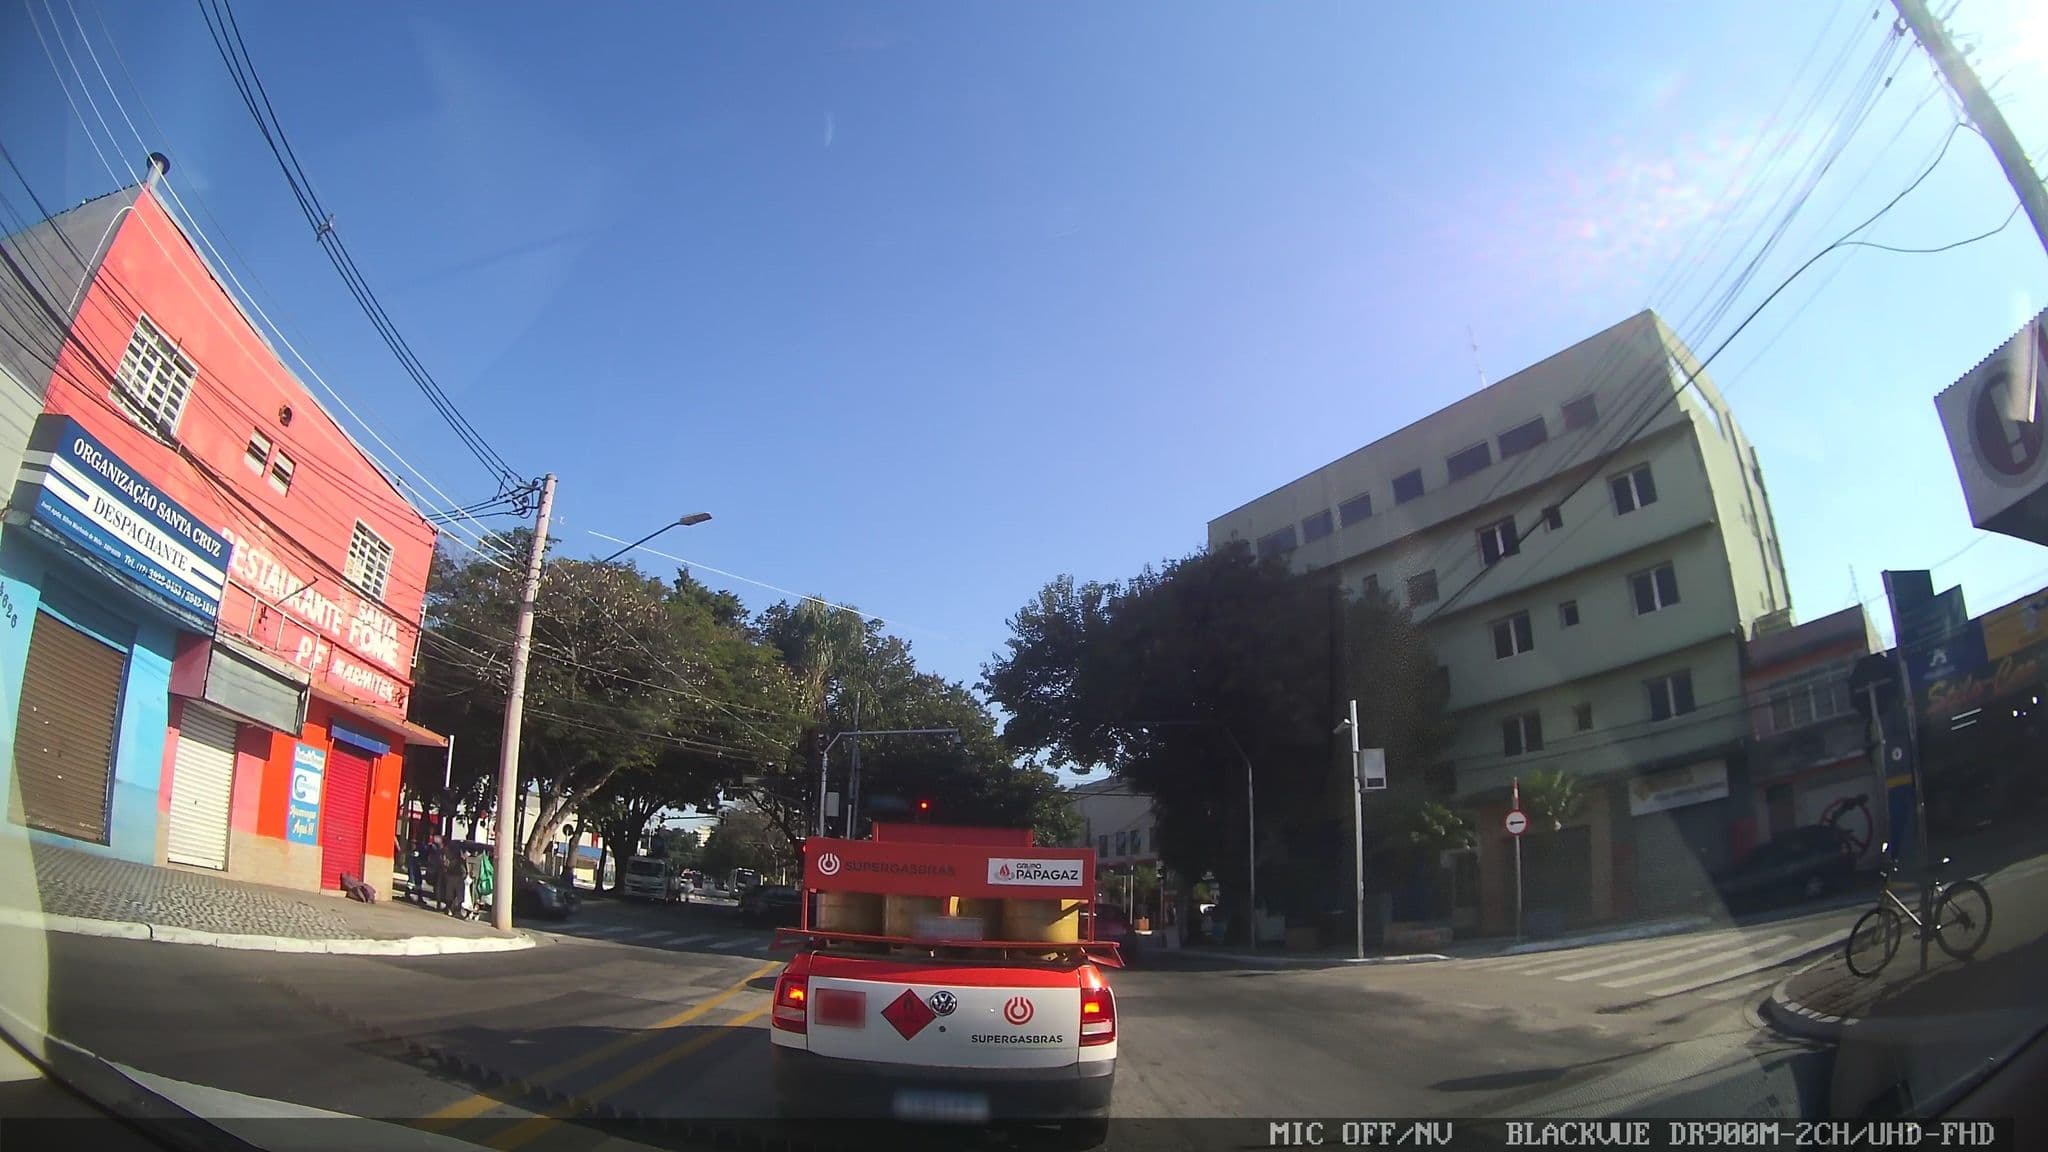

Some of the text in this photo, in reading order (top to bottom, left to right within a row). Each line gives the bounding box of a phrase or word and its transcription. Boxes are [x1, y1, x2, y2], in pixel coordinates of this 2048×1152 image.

[74, 438, 157, 511] ORGANIZAÇÃO
[157, 501, 191, 536] SANTA
[192, 529, 222, 558] CRUZ
[93, 496, 188, 572] DESPACHANTE
[357, 600, 398, 639] SANTA
[349, 619, 400, 667] FOME
[845, 860, 956, 876] SUPERGASBRAS
[1016, 870, 1078, 880] PAPAGAZ
[971, 1034, 1063, 1044] SUPERGASBRAS
